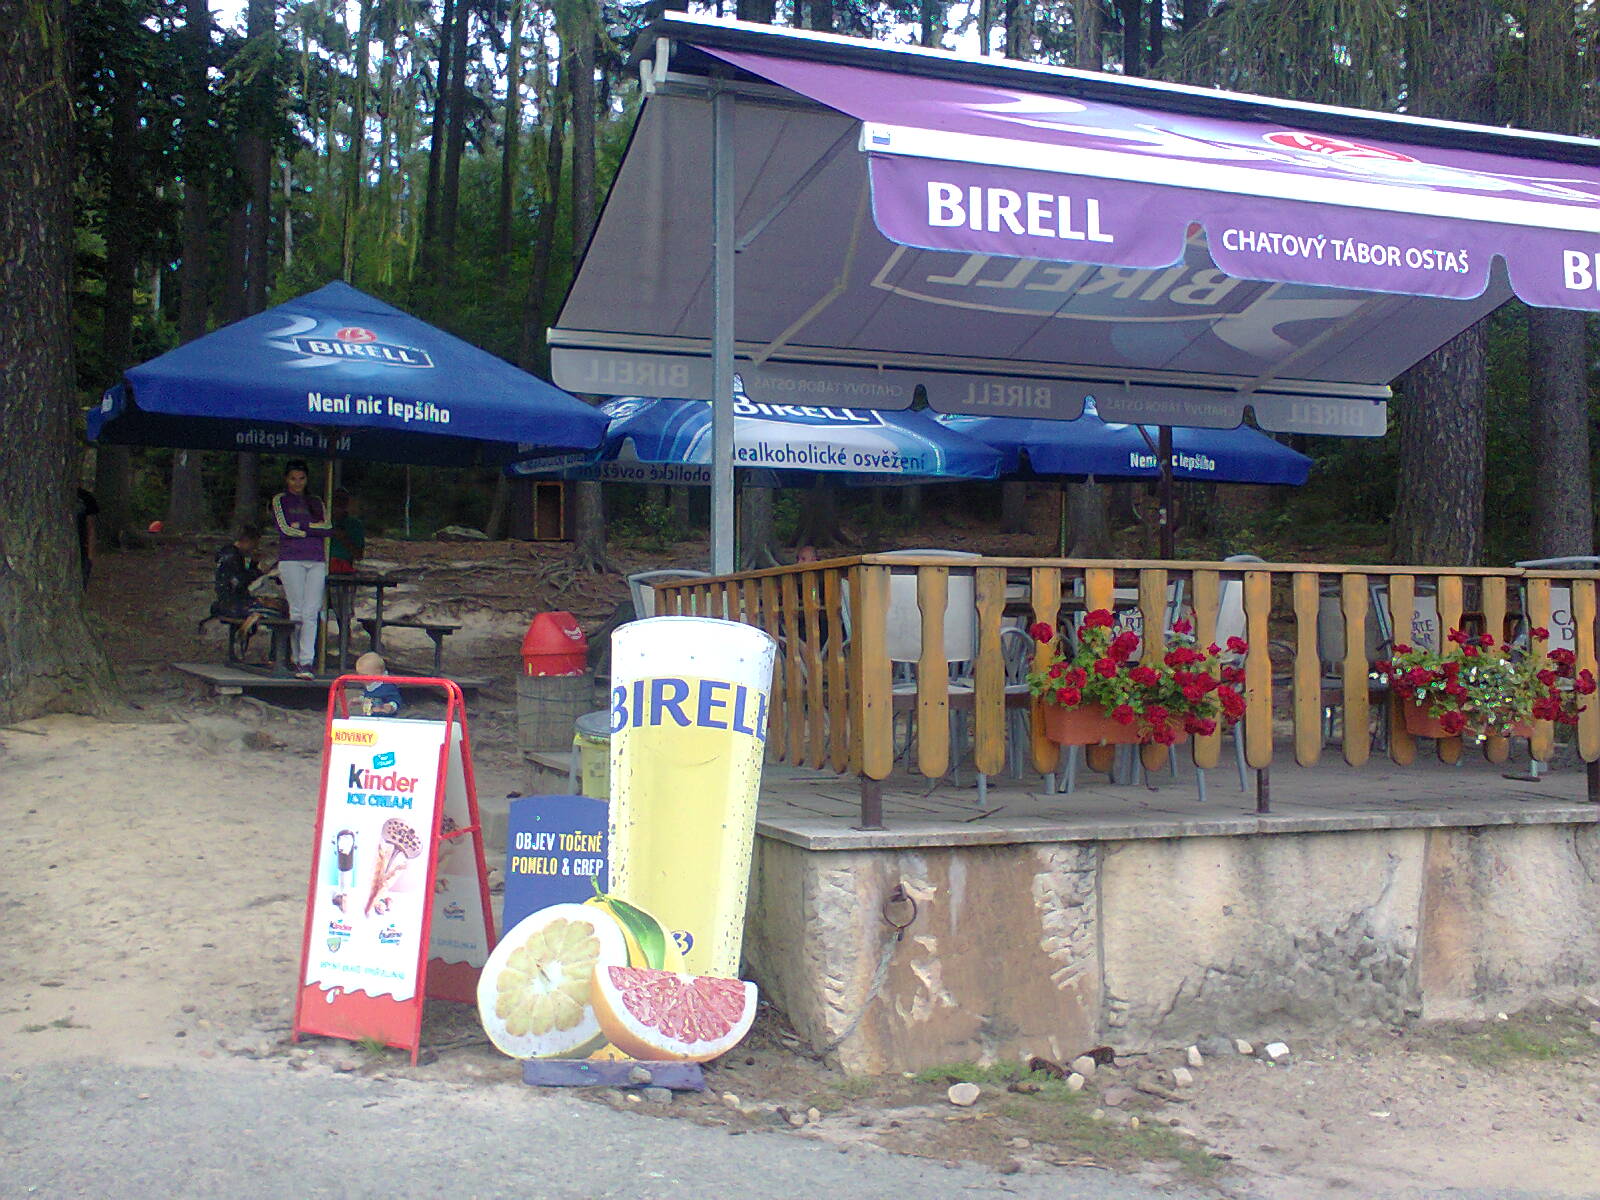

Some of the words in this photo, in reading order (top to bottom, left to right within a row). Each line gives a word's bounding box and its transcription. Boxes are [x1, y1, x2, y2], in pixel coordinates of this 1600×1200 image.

[927, 181, 1114, 243] BIRELL
[1222, 229, 1327, 259] CHATOVÝ
[1331, 238, 1401, 267] TÁBOR
[1405, 248, 1469, 274] OSTAŠ
[308, 341, 417, 363] BIRELL
[308, 392, 351, 414] Není
[356, 395, 382, 414] nic
[388, 396, 450, 423] lepšího
[853, 450, 926, 470] osvěžení
[335, 731, 374, 743] NOVINKY
[347, 792, 366, 806] ICE
[368, 794, 413, 809] CREAM
[515, 832, 556, 851] OBJEV
[559, 830, 603, 852] TOČENÉ
[511, 856, 558, 875] POMELO
[561, 857, 570, 876] &
[573, 858, 604, 876] GREP
